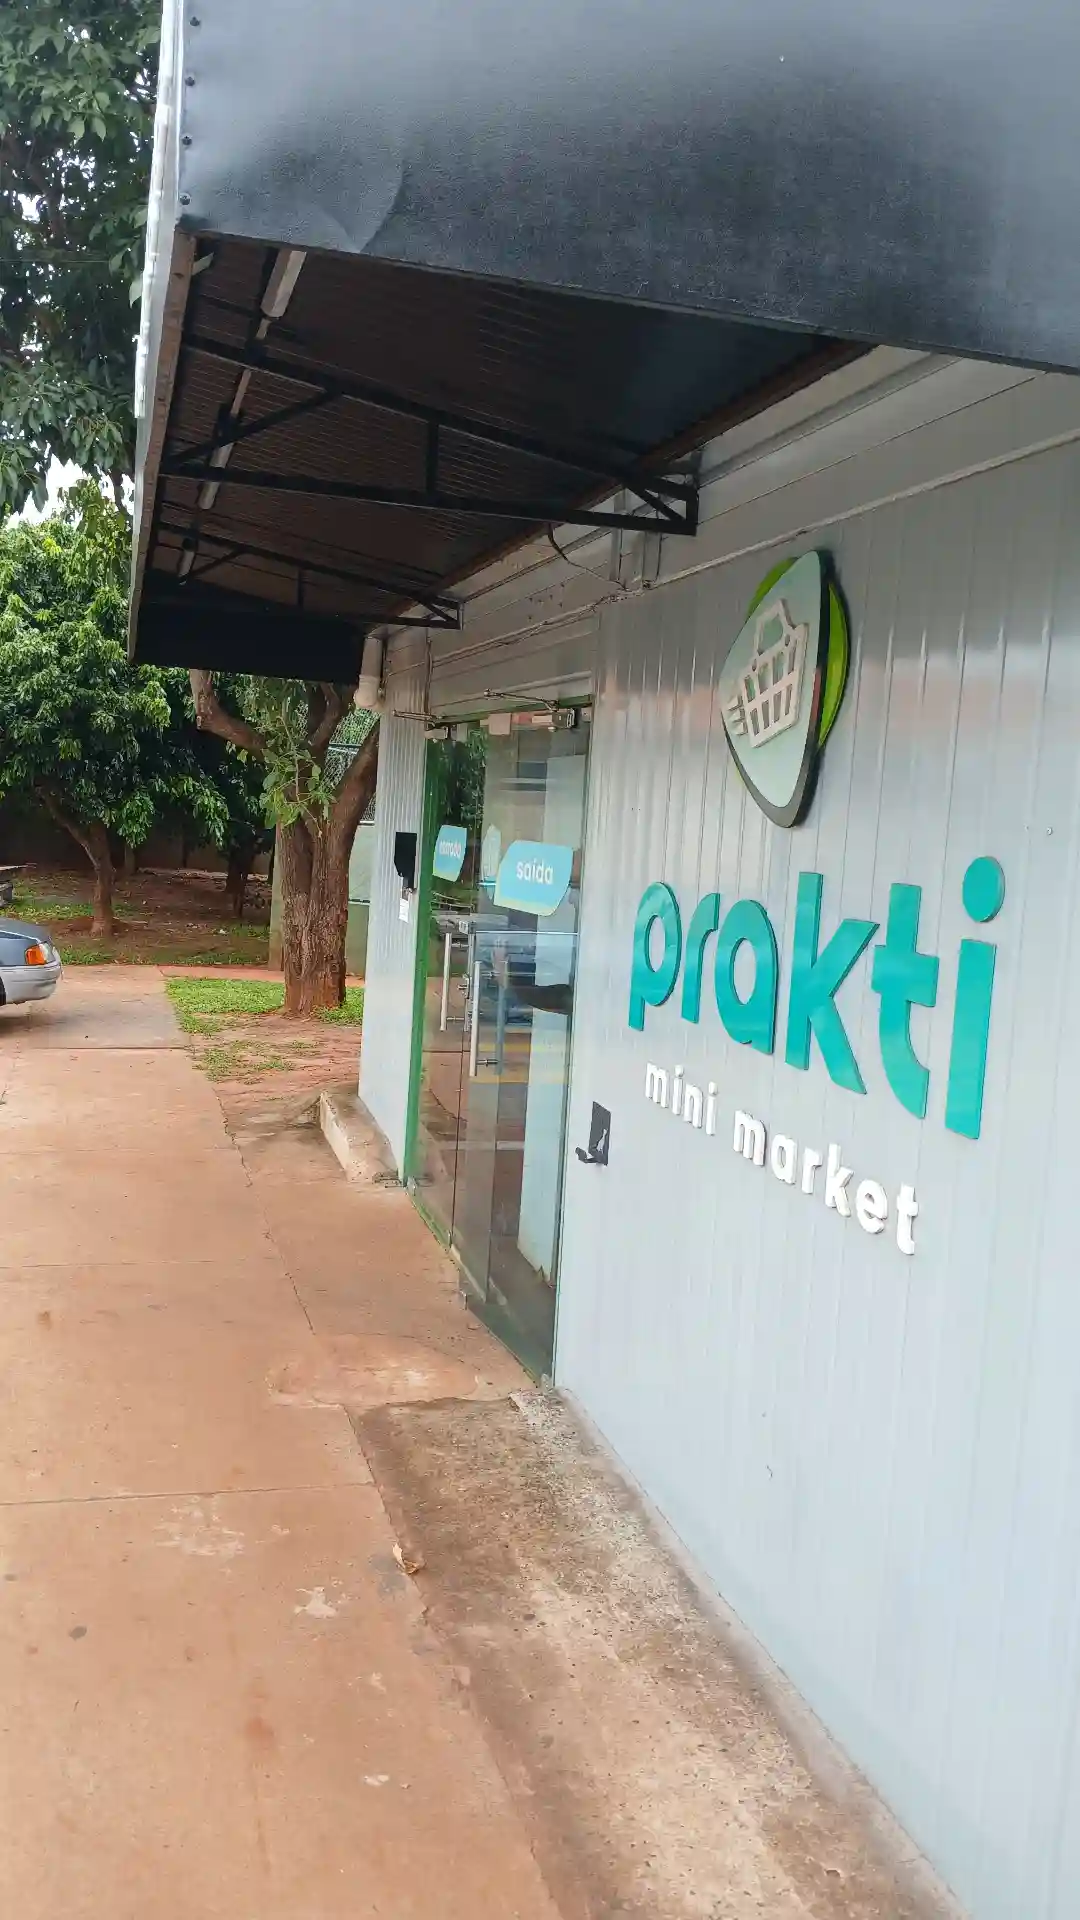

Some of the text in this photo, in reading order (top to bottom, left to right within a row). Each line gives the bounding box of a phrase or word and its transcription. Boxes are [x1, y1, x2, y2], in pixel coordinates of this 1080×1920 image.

[516, 859, 553, 885] saída
[628, 856, 1005, 1139] prakti
[645, 1062, 918, 1255] mini market
